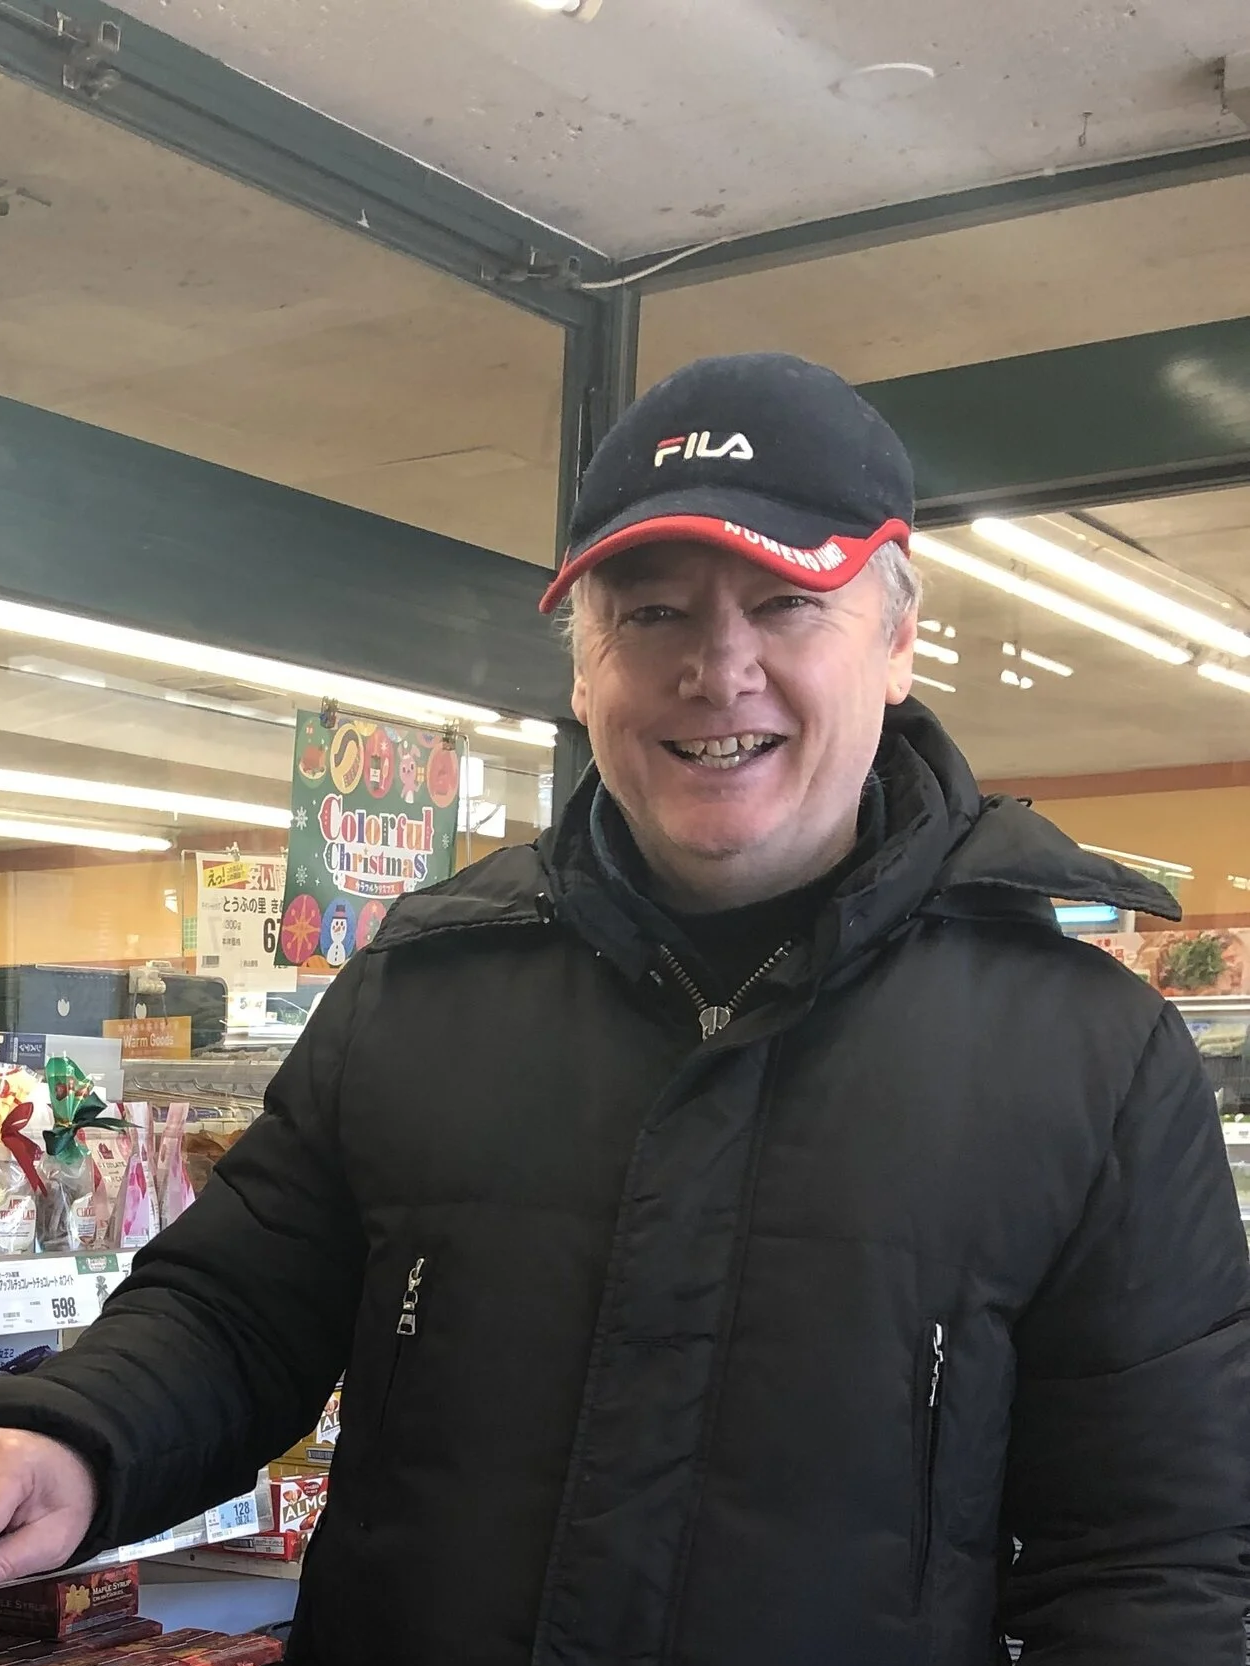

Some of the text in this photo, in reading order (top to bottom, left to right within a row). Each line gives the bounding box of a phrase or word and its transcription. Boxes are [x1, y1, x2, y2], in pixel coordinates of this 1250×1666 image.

[654, 431, 754, 468] FILA
[724, 520, 821, 573] NUMERO
[319, 796, 433, 852] Colorful
[325, 842, 427, 880] Christmas
[223, 896, 266, 914] とうふの里
[123, 1033, 175, 1048] Warm Goods
[51, 1297, 77, 1319] 598
[233, 1501, 250, 1516] 128
[92, 1579, 132, 1597] MAPLE SYRUP
